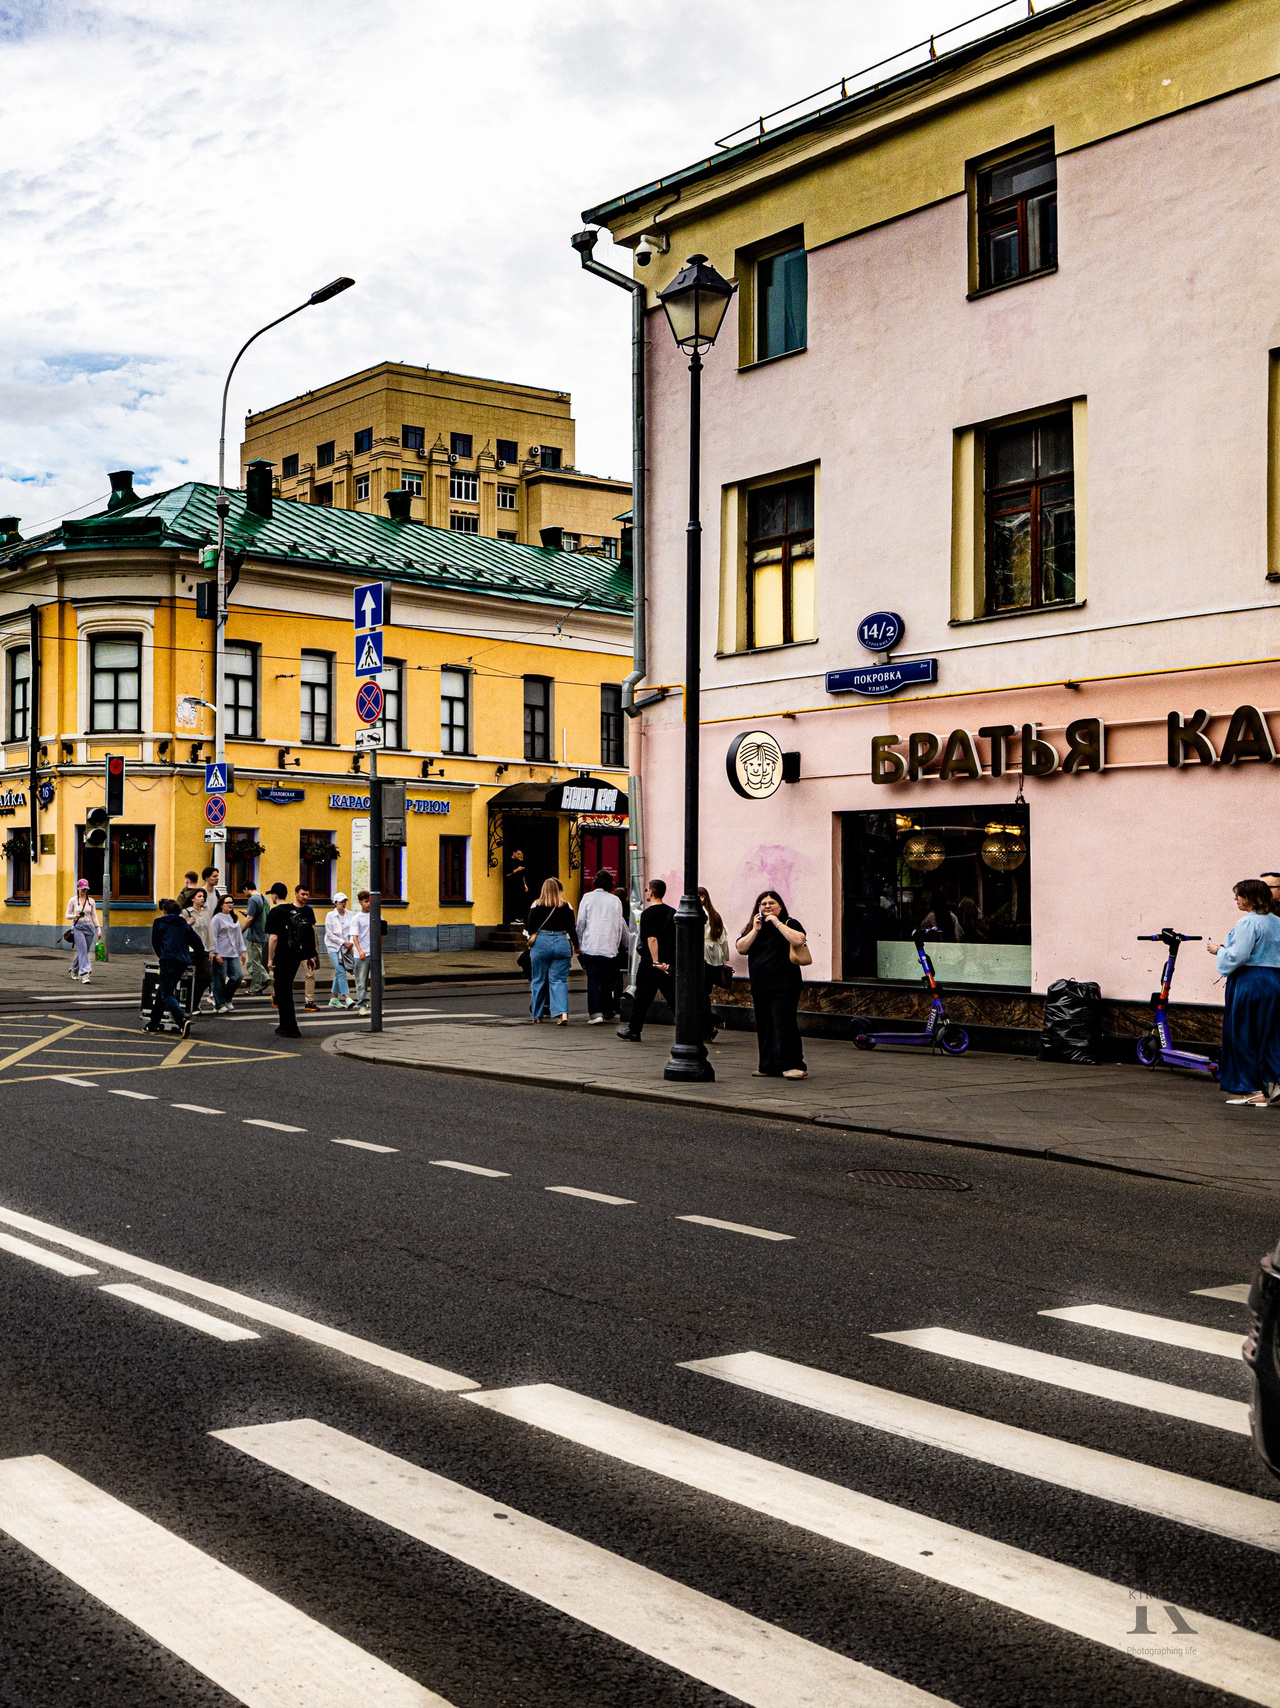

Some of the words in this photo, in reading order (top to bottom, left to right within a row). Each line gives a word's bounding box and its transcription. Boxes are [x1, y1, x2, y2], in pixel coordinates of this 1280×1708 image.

[862, 622, 894, 639] 14/2
[854, 671, 901, 684] ПОКРОВКА
[867, 684, 889, 692] УЛИЦА
[870, 717, 1106, 785] БРАТЬЯ
[42, 787, 49, 798] 16
[415, 799, 451, 813] ТРЮМ
